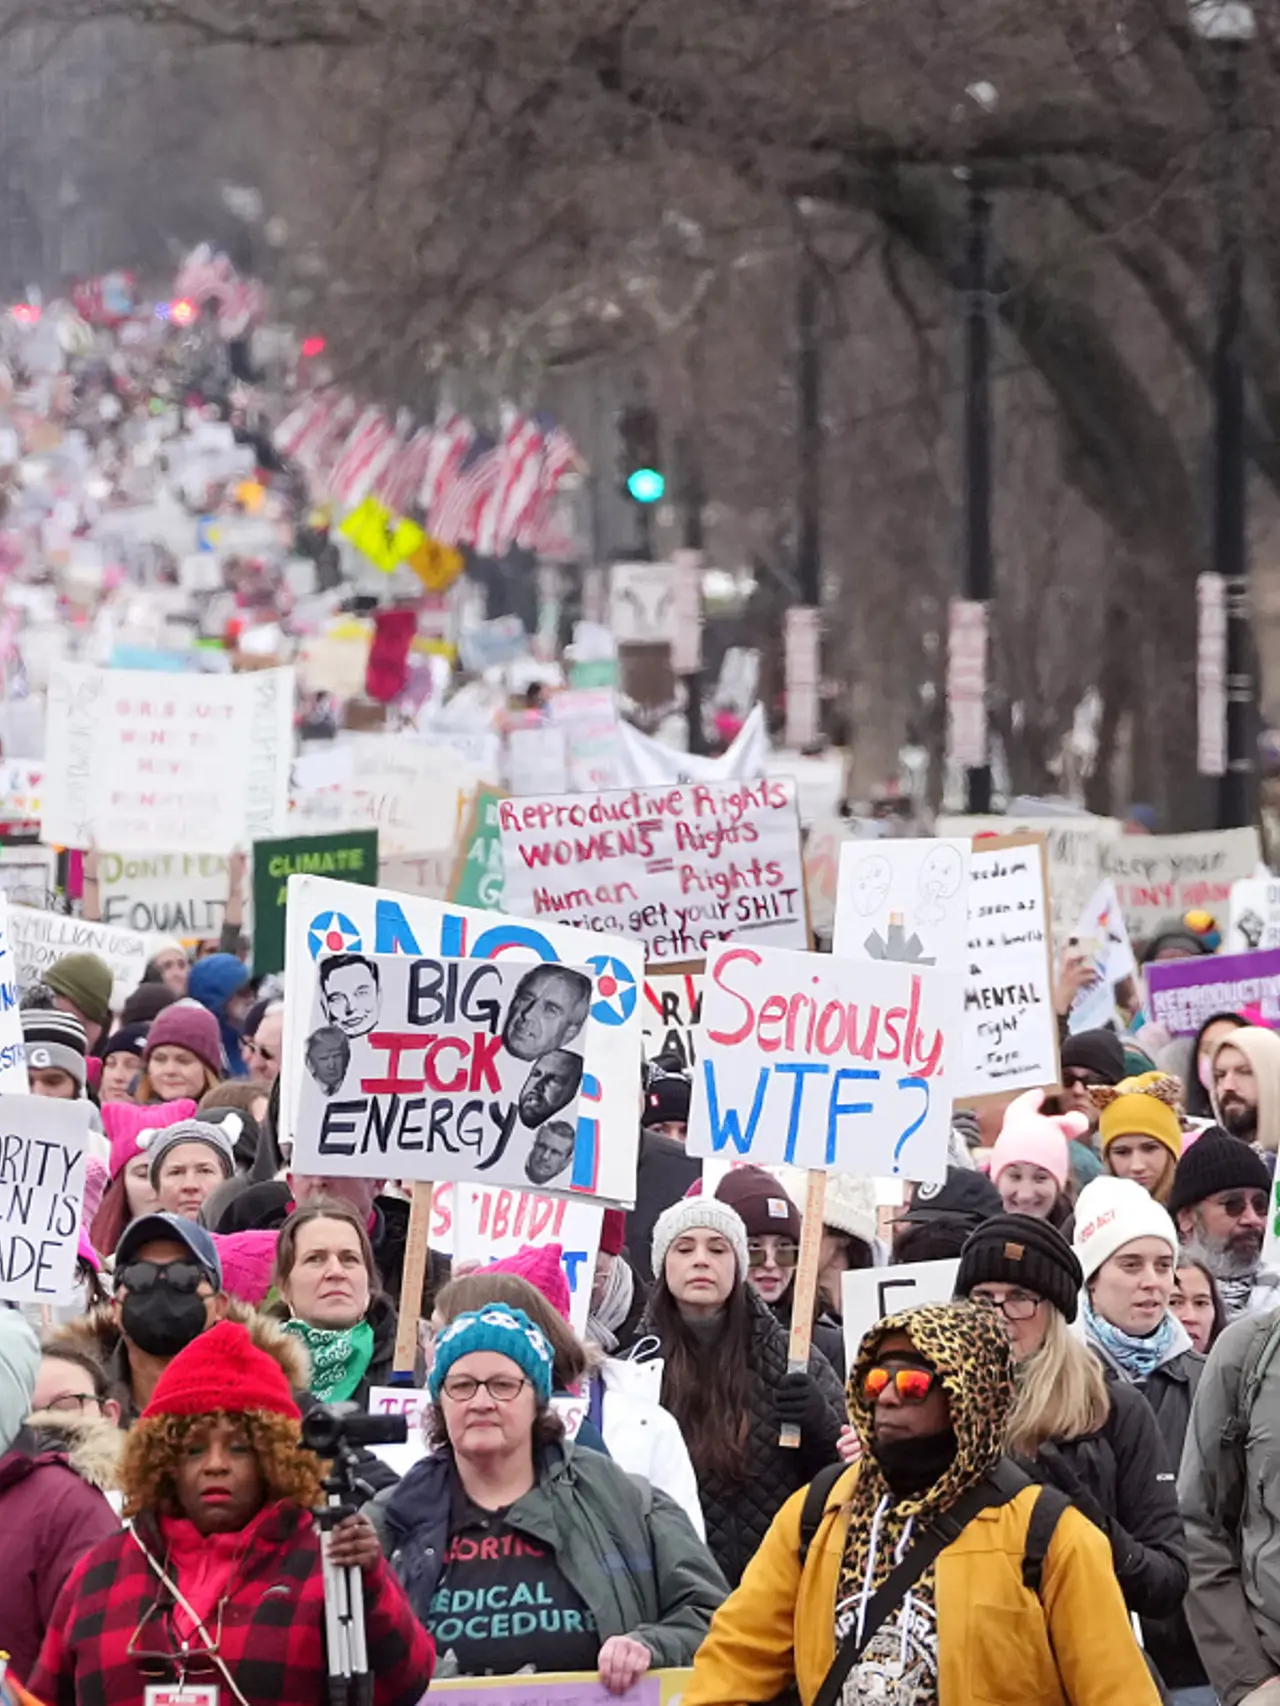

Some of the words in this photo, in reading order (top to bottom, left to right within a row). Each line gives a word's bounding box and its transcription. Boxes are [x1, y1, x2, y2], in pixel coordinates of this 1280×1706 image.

[499, 788, 684, 832] Reproductive
[691, 779, 788, 821] Rights
[675, 820, 759, 859] Rights
[268, 848, 365, 877] CLIMATE
[532, 881, 639, 915] Human
[679, 858, 785, 899] Rights
[629, 901, 669, 932] get
[673, 901, 730, 934] your
[736, 889, 799, 922] SHIT
[407, 958, 504, 1035] BIG
[963, 982, 1042, 1012] MENTAL
[360, 1031, 504, 1095] ICK
[318, 1093, 519, 1170] ENERGY
[47, 1193, 79, 1236] IS
[429, 1582, 553, 1613] EDICAL
